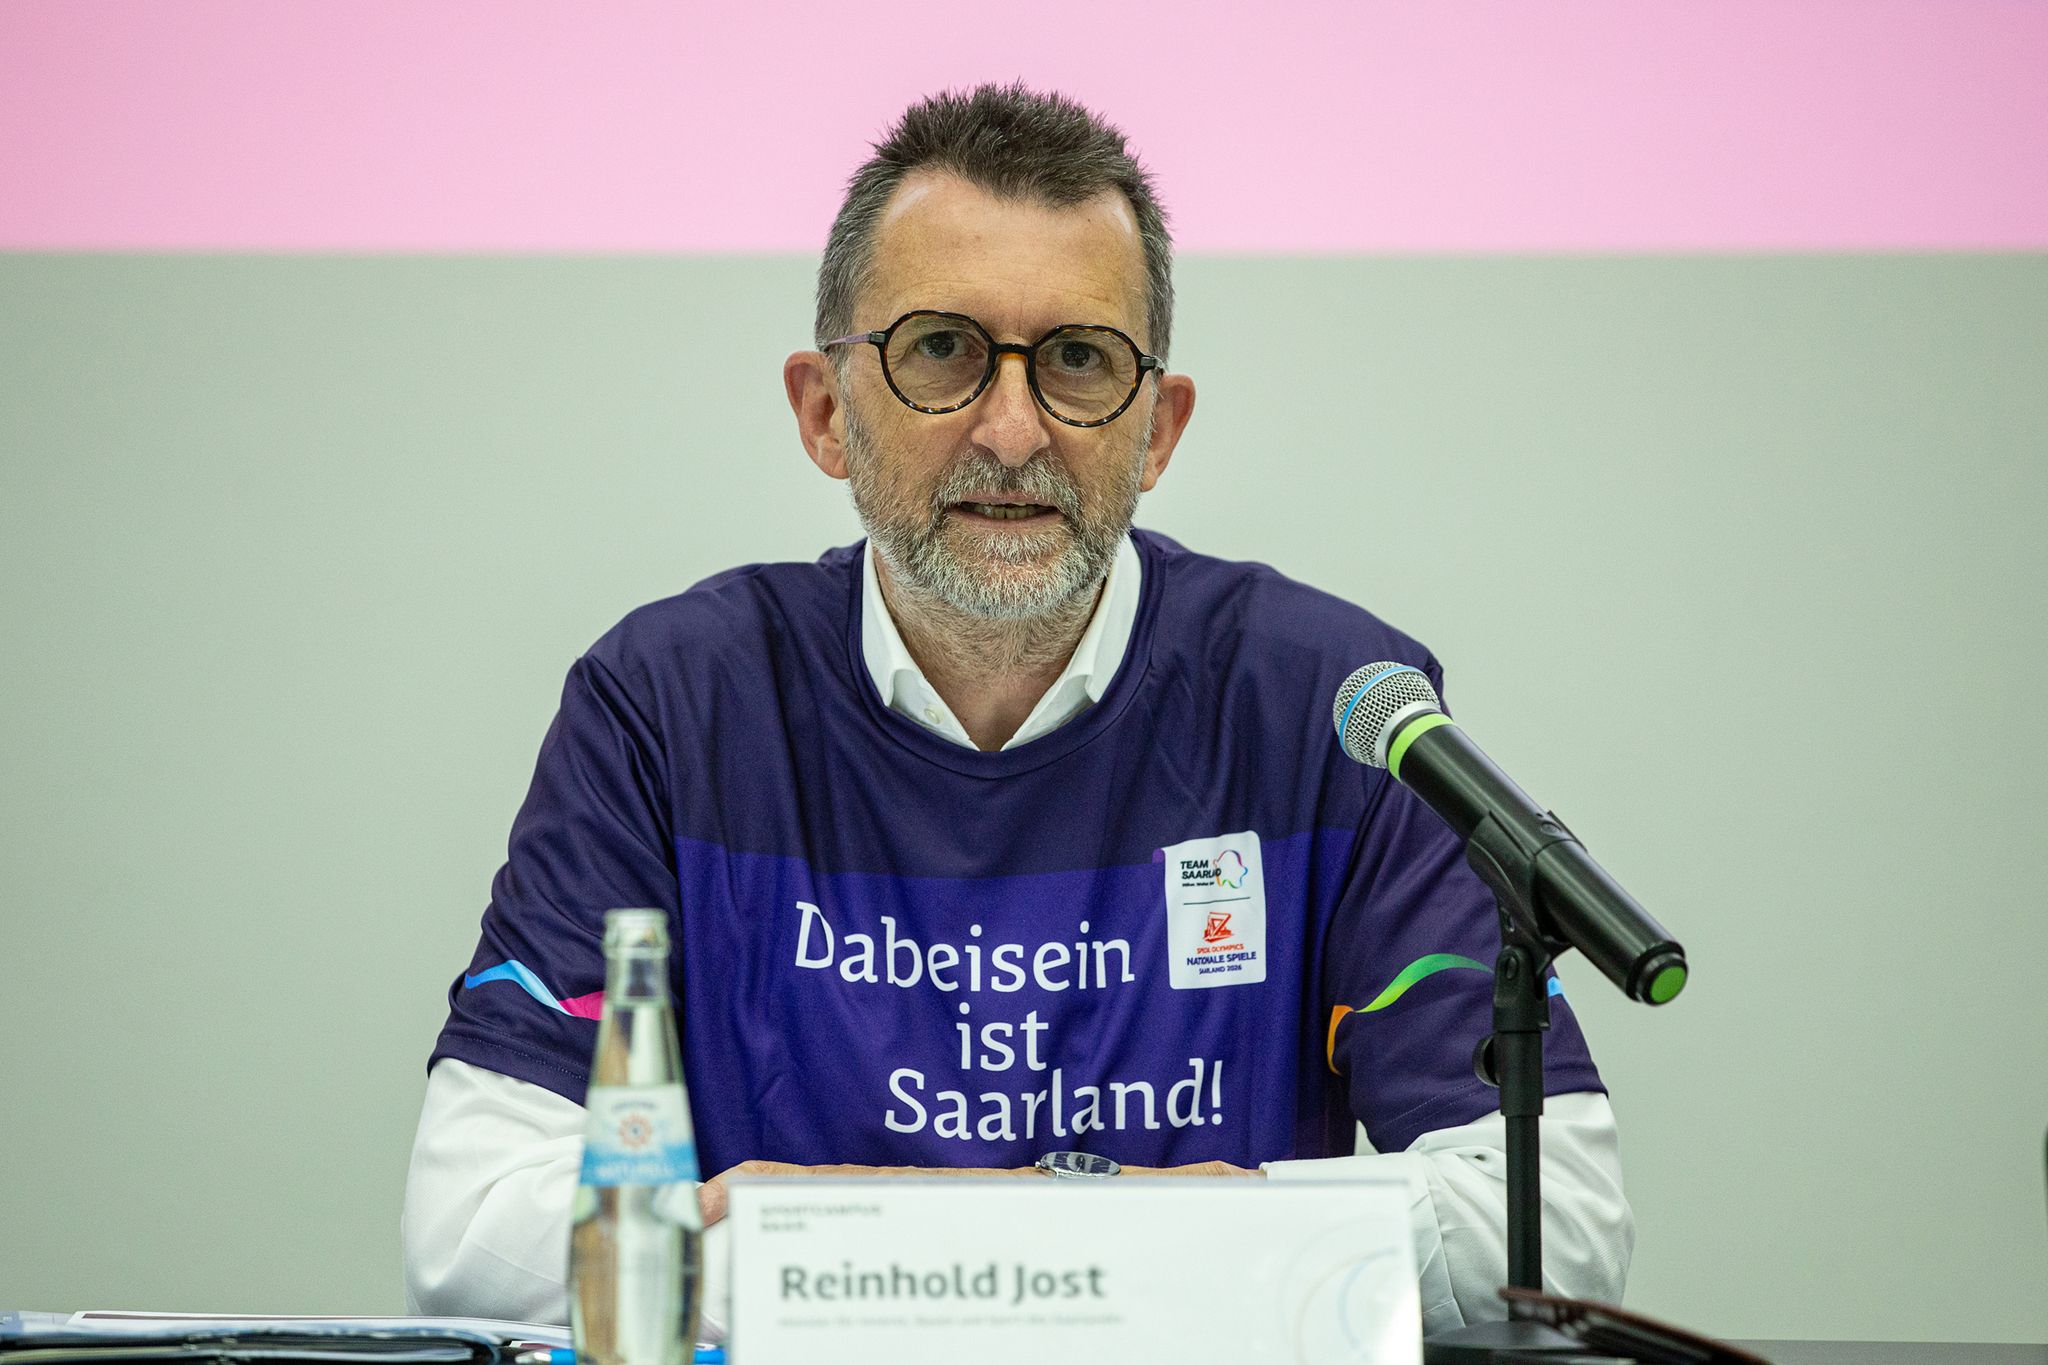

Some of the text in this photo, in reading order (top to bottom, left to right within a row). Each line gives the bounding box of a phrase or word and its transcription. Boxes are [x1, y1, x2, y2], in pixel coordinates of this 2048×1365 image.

[1180, 860, 1209, 869] TEAM
[795, 901, 1135, 992] Dabeisein
[1226, 951, 1257, 962] SPIELE
[956, 1002, 1049, 1071] ist
[884, 1058, 1224, 1141] Saarland!
[780, 1261, 1108, 1306] Reinhold Jost
